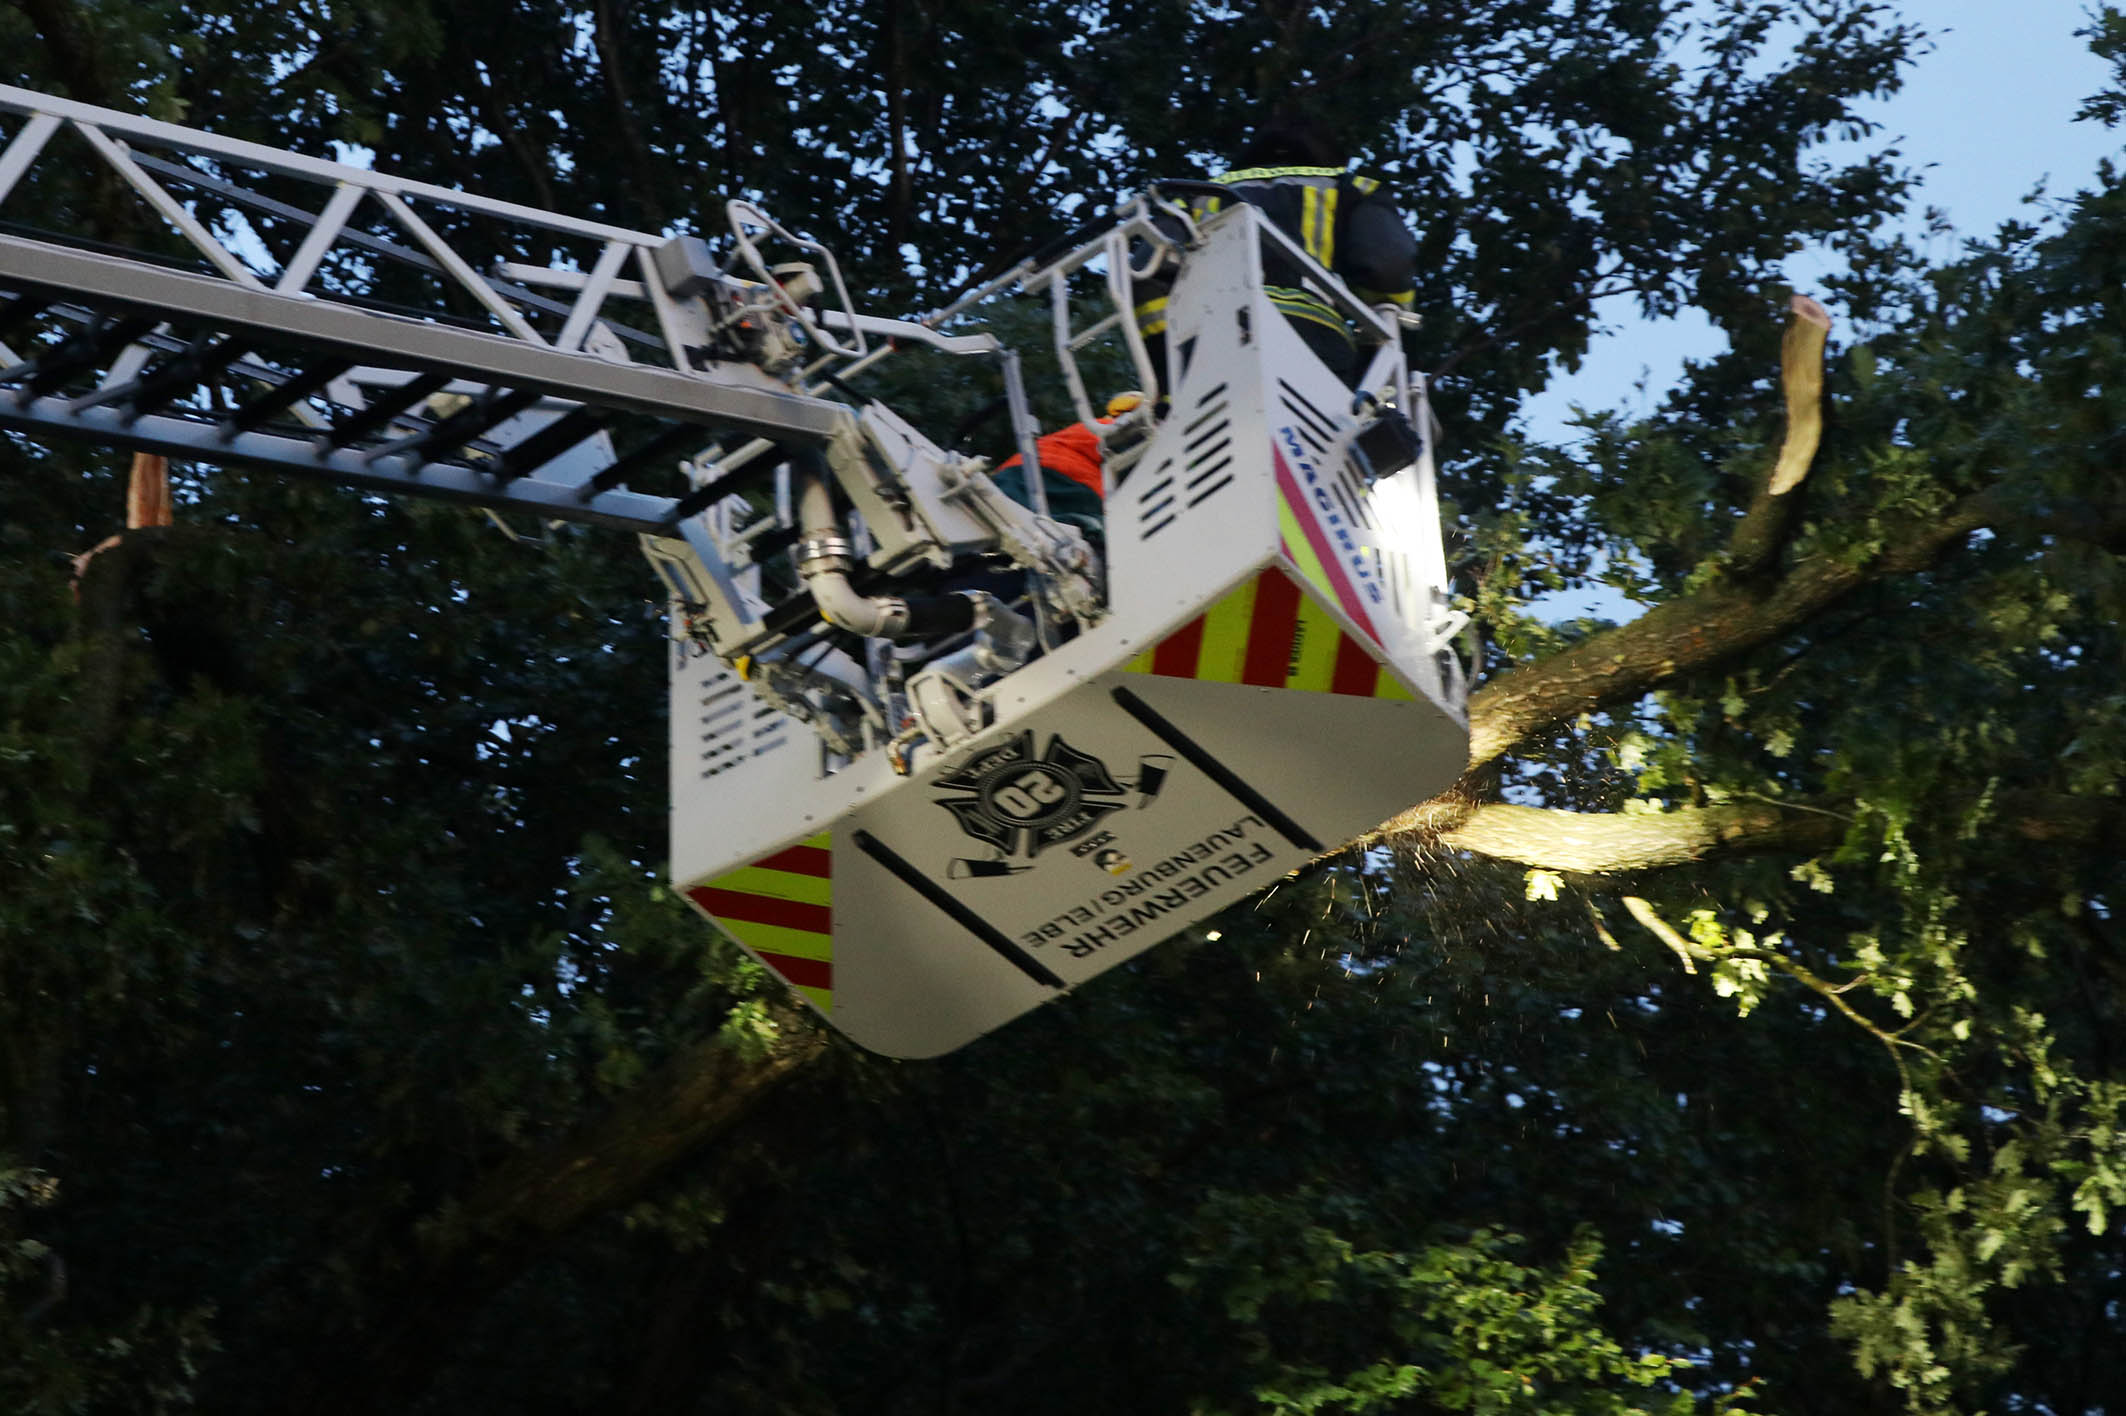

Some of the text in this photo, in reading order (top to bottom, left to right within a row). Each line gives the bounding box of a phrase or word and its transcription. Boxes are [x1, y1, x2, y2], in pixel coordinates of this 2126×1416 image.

[994, 771, 1067, 818] 20
[1043, 812, 1095, 840] FIRE
[1060, 842, 1274, 958] FEUERWEHR
